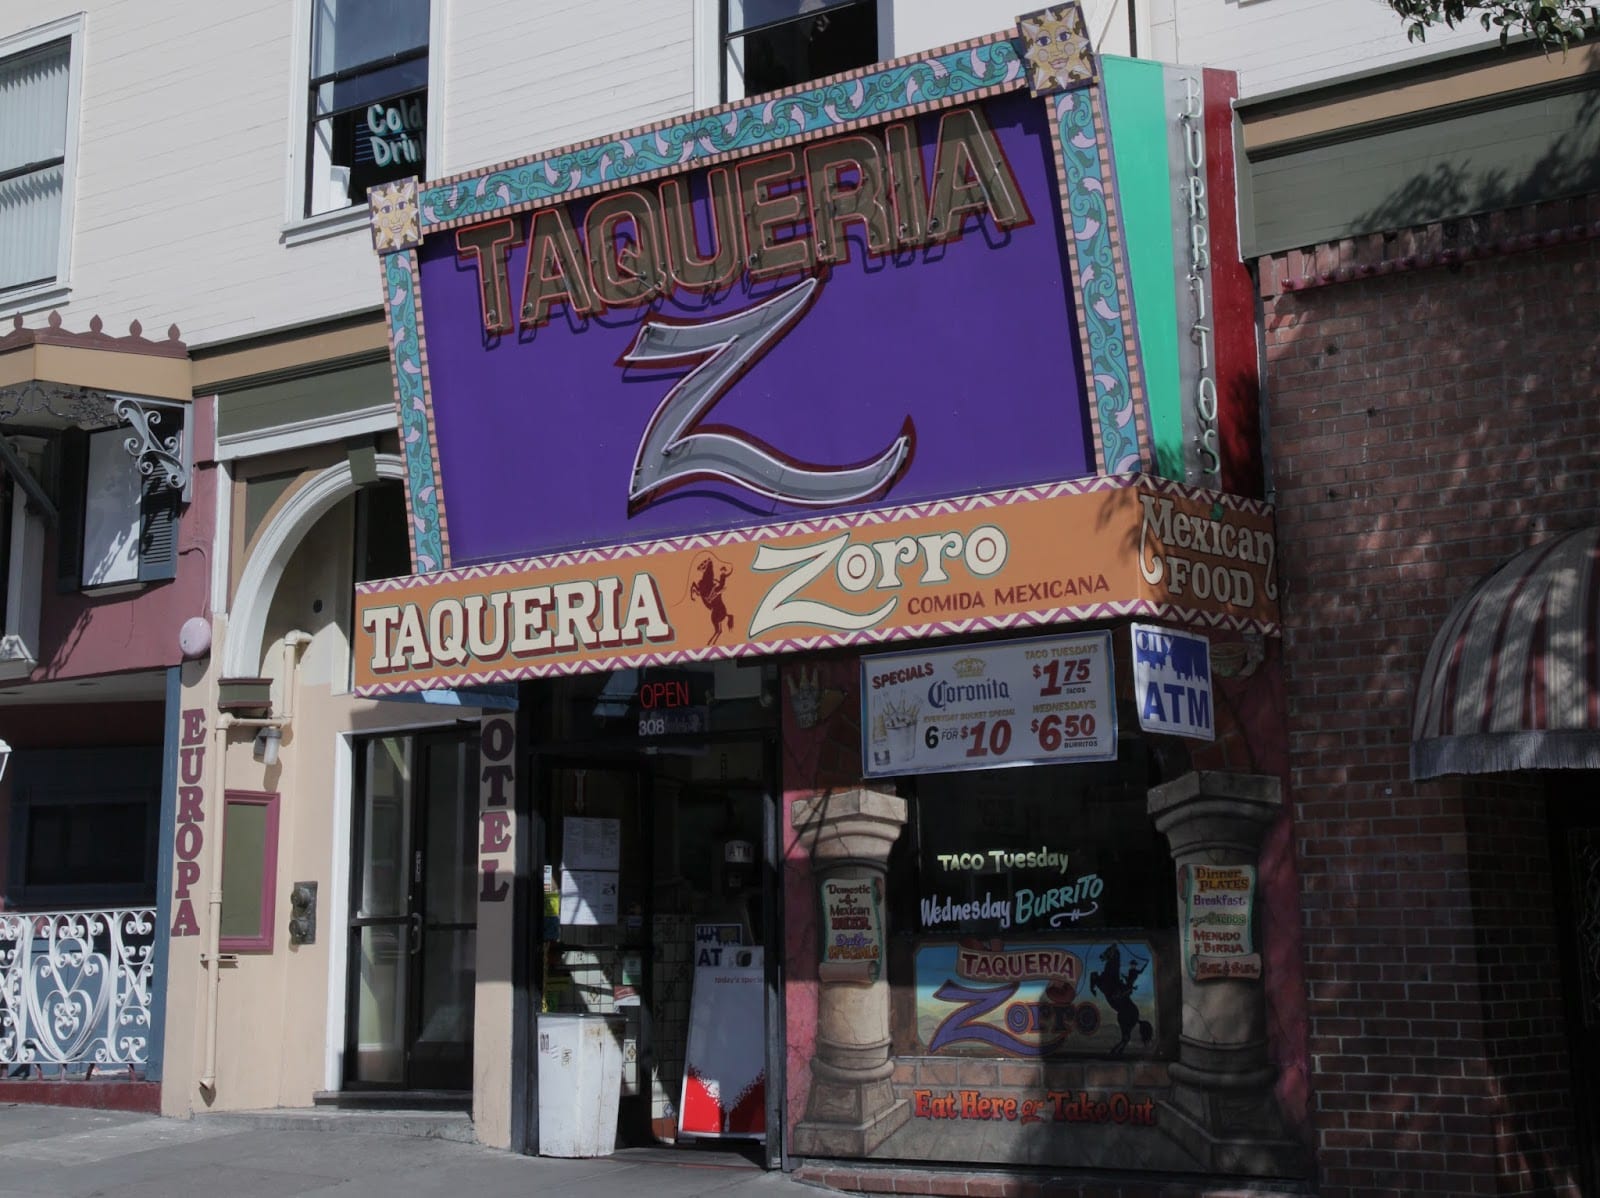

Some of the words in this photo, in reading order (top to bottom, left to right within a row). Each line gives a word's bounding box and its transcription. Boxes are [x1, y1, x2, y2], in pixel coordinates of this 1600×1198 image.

[367, 98, 423, 135] Cold
[455, 105, 1035, 336] TAQUERIA
[614, 275, 916, 519] Z
[1139, 494, 1278, 600] Mexican
[907, 590, 986, 616] COMIDA
[994, 574, 1110, 606] MEXICANA
[1166, 555, 1254, 608] FOOD
[363, 572, 674, 675] TAQUERIA
[749, 525, 1009, 638] Zorro
[1024, 650, 1048, 660] TACO
[1051, 644, 1098, 657] TUESDAYS
[872, 662, 934, 690] SPECIALS
[641, 680, 689, 709] OPEN
[928, 678, 1009, 711] Coronita
[1032, 700, 1097, 713] WEDNESDAYS
[1143, 681, 1210, 729] ATM
[925, 725, 939, 749] 6
[941, 731, 959, 740] FOR
[960, 719, 1012, 757] $10
[170, 708, 207, 936] EUROPA
[479, 718, 515, 902] OTEL
[937, 852, 985, 872] TACO
[988, 846, 1069, 874] Tuesday
[826, 884, 871, 894] Domestic
[830, 903, 870, 917] Mexican
[920, 892, 1011, 928] Wednesday
[1193, 929, 1241, 941] MENUDO
[698, 948, 723, 967] AT
[960, 952, 1076, 980] TAQUERIA
[929, 979, 1100, 1057] Zorro
[913, 1088, 958, 1120] Eat
[959, 1089, 1019, 1121] Here
